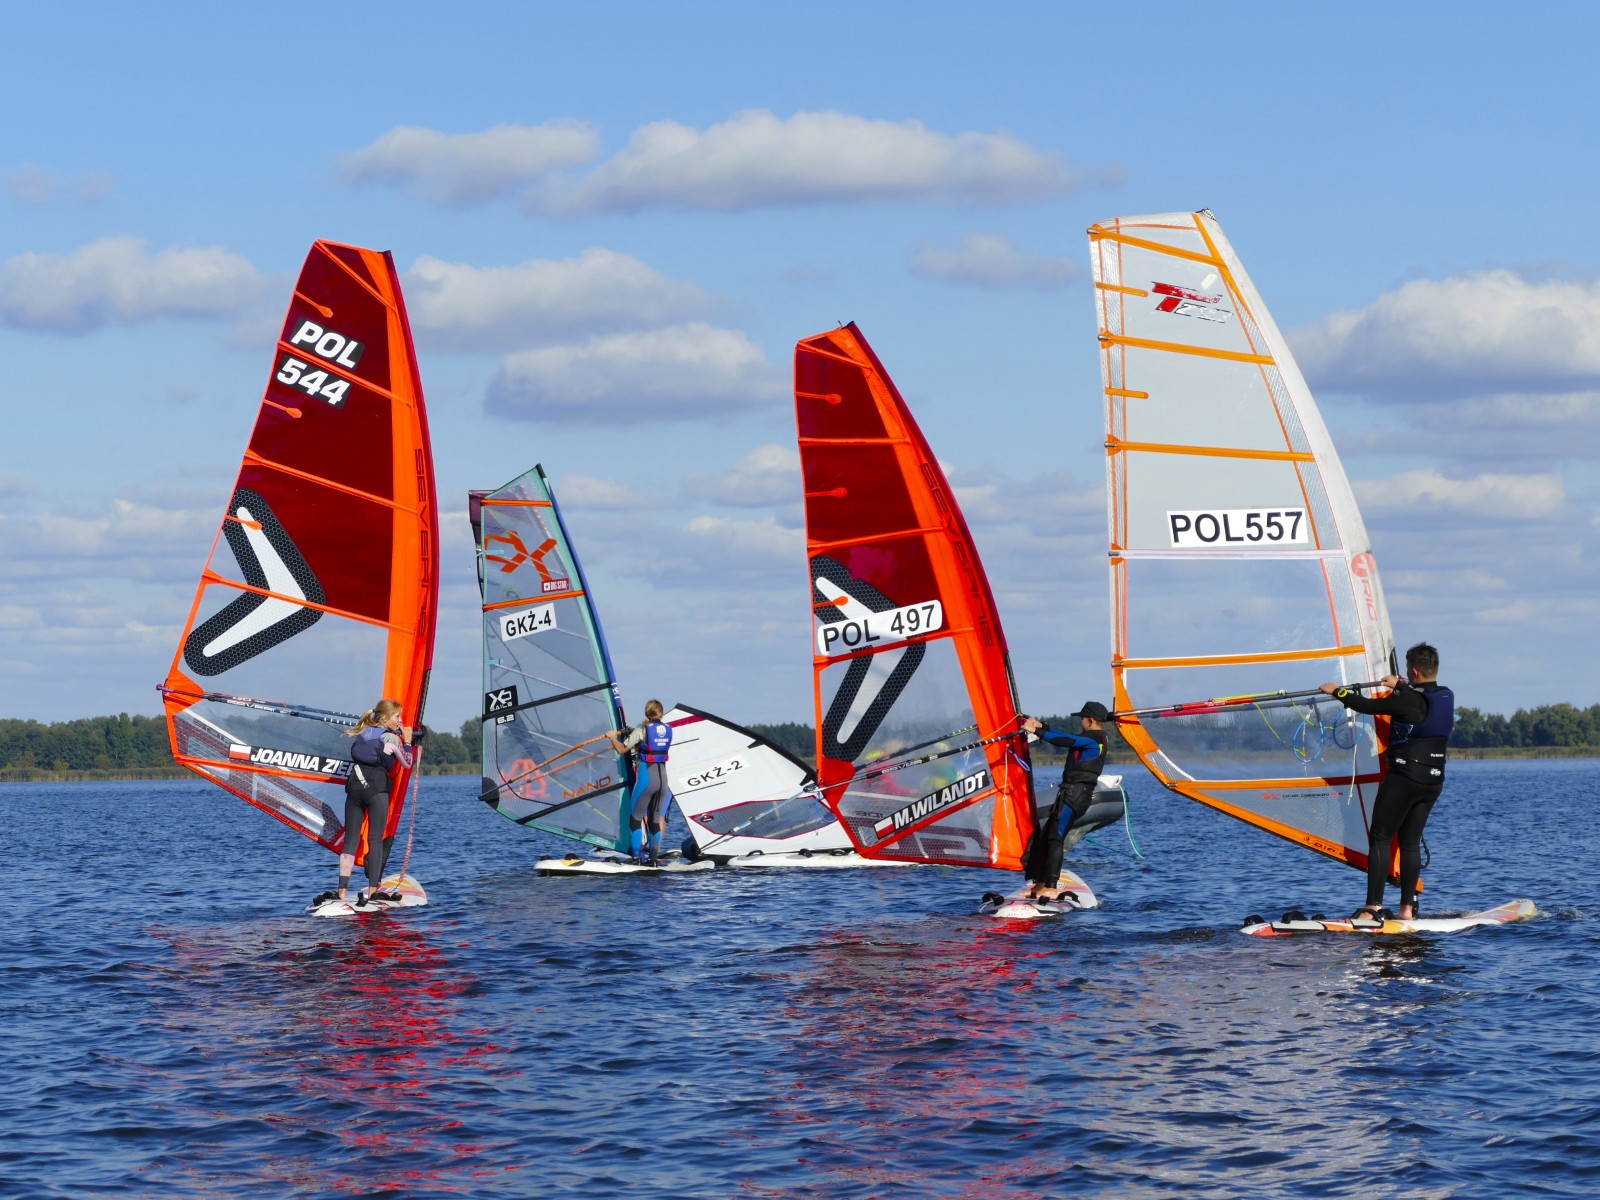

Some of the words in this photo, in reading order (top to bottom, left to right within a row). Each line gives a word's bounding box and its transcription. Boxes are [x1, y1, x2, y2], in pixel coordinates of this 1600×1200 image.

[290, 320, 359, 369] POL
[276, 357, 351, 406] 544
[1170, 511, 1303, 543] POL557
[505, 609, 552, 637] GKŻ-4
[822, 618, 880, 652] POL
[890, 604, 935, 635] 497
[250, 748, 320, 771] JOANNA
[687, 760, 743, 787] GKŻ-2
[563, 776, 611, 801] NANO
[893, 771, 987, 830] M.WILANDT
